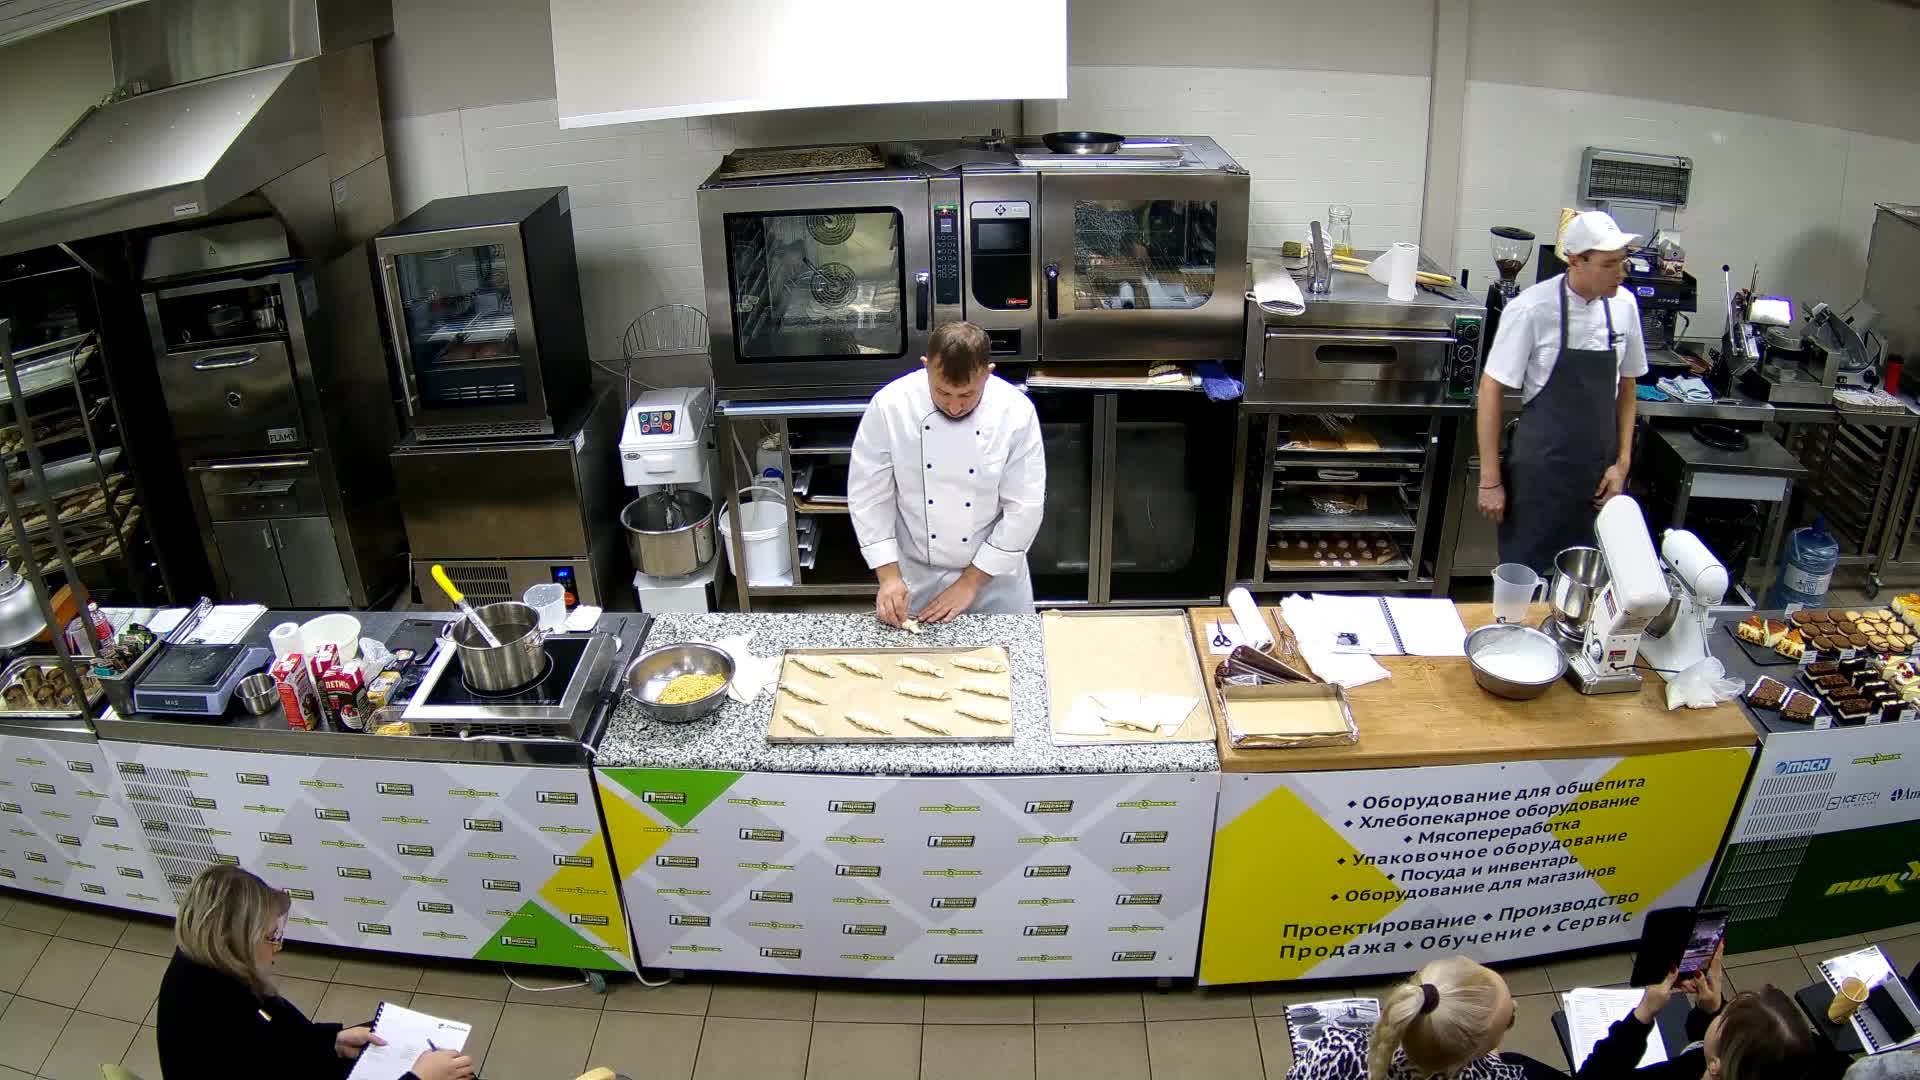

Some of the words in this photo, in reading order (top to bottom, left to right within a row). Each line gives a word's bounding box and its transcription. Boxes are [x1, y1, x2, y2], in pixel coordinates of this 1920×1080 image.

[1788, 759, 1830, 773] MACH
[1362, 790, 1512, 811] Оборудование
[1515, 786, 1551, 801] для
[1556, 778, 1646, 796] общепита
[1842, 791, 1881, 804] ICETECH
[1359, 809, 1510, 829] Хлебопекарное
[1516, 796, 1640, 818] оборудование
[1353, 848, 1488, 866] Упаковочное
[1493, 831, 1628, 857] оборудование
[1418, 819, 1581, 845] Мясопереработка
[1345, 883, 1485, 903] Оборудование
[1488, 878, 1522, 892] для
[1527, 866, 1617, 887] магазинов
[1401, 867, 1466, 882] Посуда
[1472, 866, 1483, 876] и
[1487, 855, 1579, 875] инвентарь
[1283, 914, 1477, 941] Проектирование
[1498, 892, 1640, 923] Производство
[1279, 942, 1396, 961] Продажа
[1420, 925, 1536, 950] Обучение
[1556, 911, 1633, 932] Сервис
